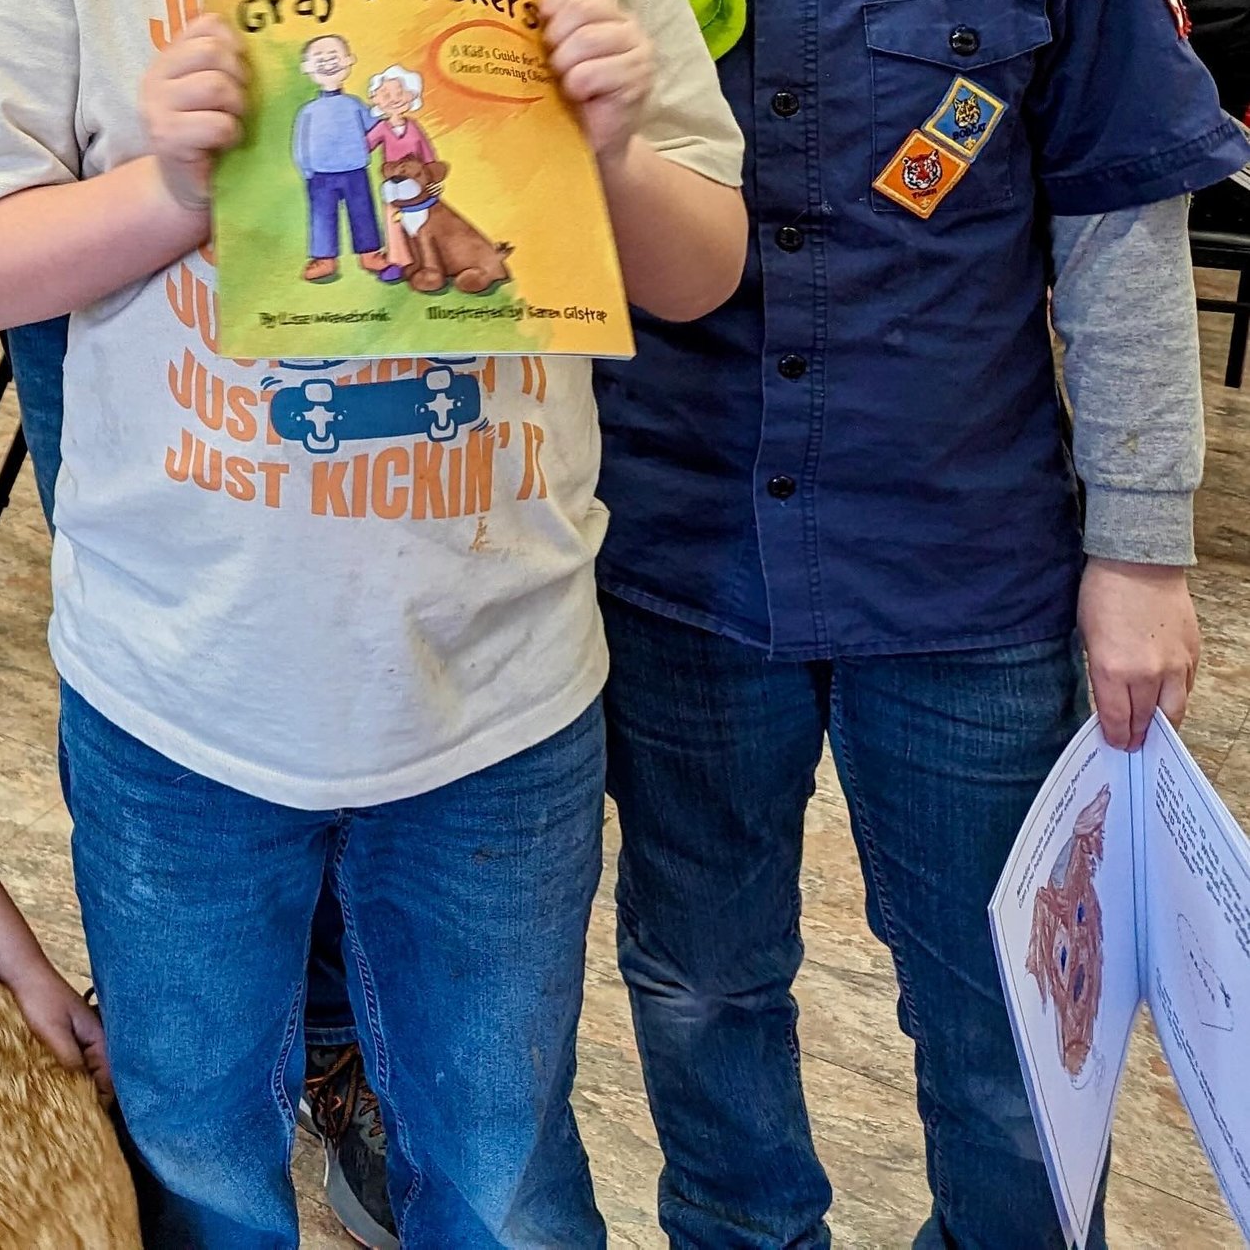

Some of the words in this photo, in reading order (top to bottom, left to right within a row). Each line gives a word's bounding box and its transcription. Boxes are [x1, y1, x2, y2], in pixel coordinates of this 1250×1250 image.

[492, 48, 520, 63] Guide
[484, 62, 527, 83] Growing
[952, 123, 987, 140] BOBCAT
[912, 187, 937, 199] TIGER
[563, 306, 608, 325] Gilstrap
[165, 428, 290, 509] JUST
[311, 421, 510, 520] KICKIN'
[1159, 757, 1175, 786] Color
[1187, 804, 1197, 824] the
